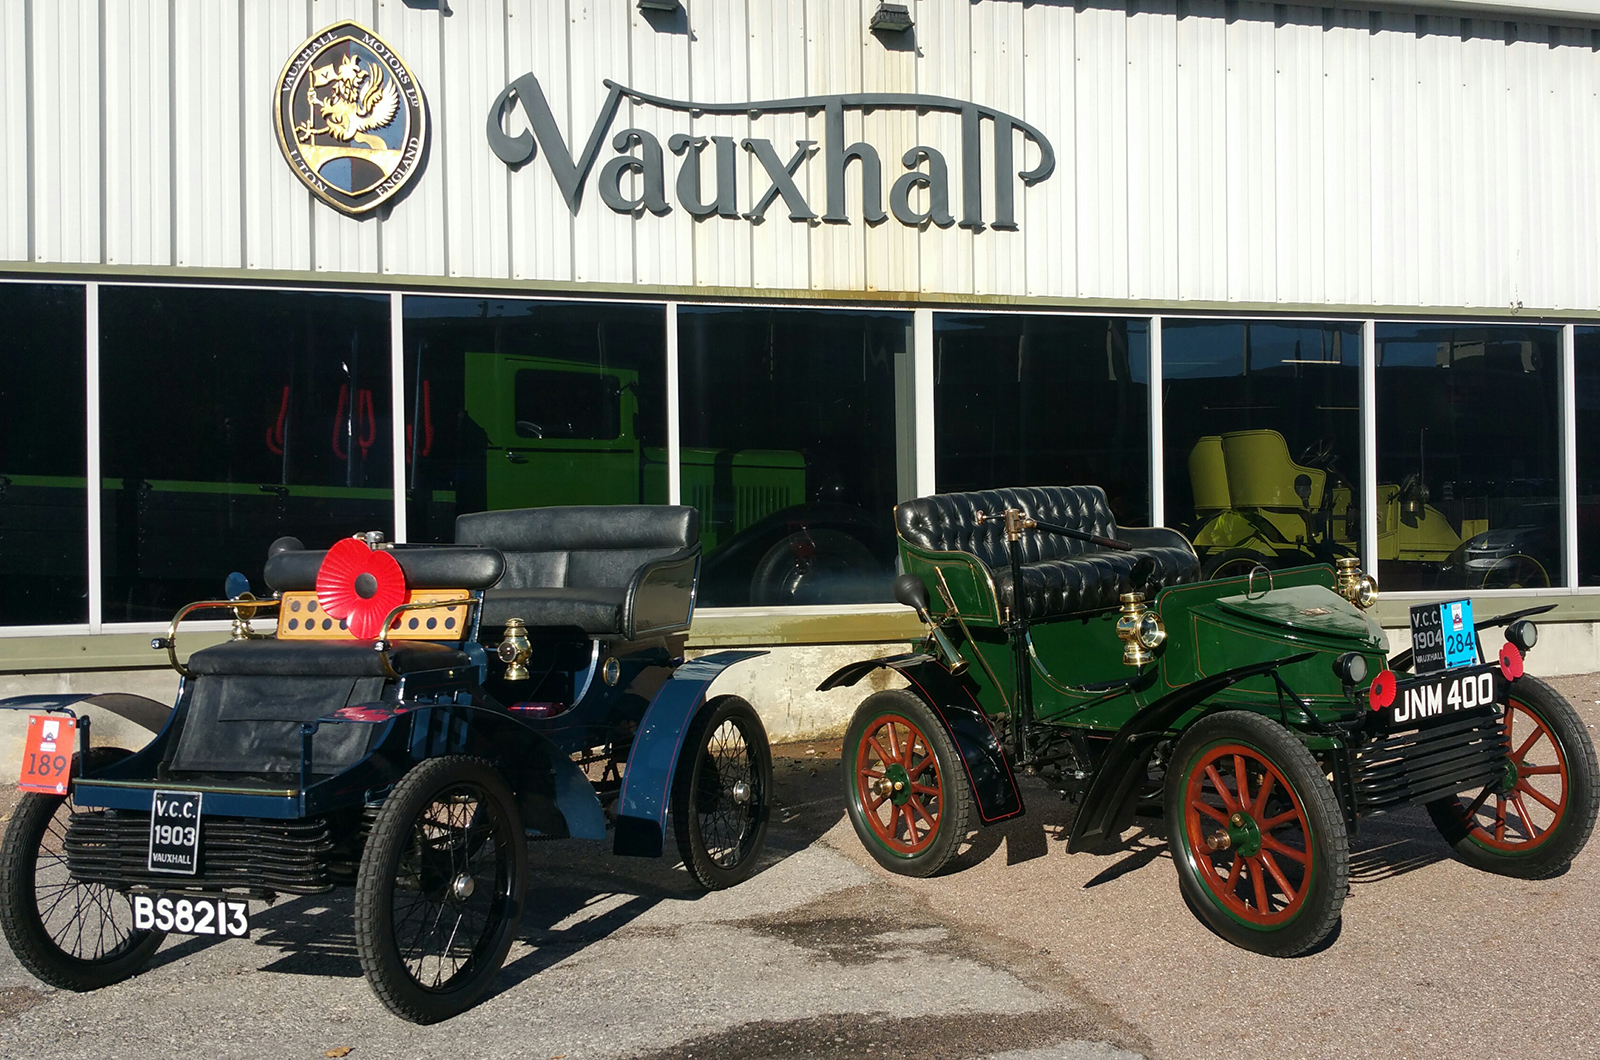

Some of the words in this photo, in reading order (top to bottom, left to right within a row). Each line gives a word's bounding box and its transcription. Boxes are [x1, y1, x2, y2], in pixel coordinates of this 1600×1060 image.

[282, 32, 338, 91] VAUXHALL
[362, 33, 411, 84] MOTORS
[487, 71, 1056, 231] Vauxhall
[375, 137, 419, 196] ENGLAND
[1411, 610, 1441, 628] V.C.C.
[1413, 629, 1443, 650] 1904
[1446, 631, 1474, 655] 284
[1415, 651, 1444, 664] VAUXHALL
[1394, 682, 1443, 723] JNM
[1447, 672, 1493, 710] 400
[28, 753, 67, 777] 189
[156, 800, 196, 819] V.C.C.
[154, 825, 196, 847] 1903
[152, 852, 192, 865] VAUXHALL
[134, 895, 248, 936] BS8213
